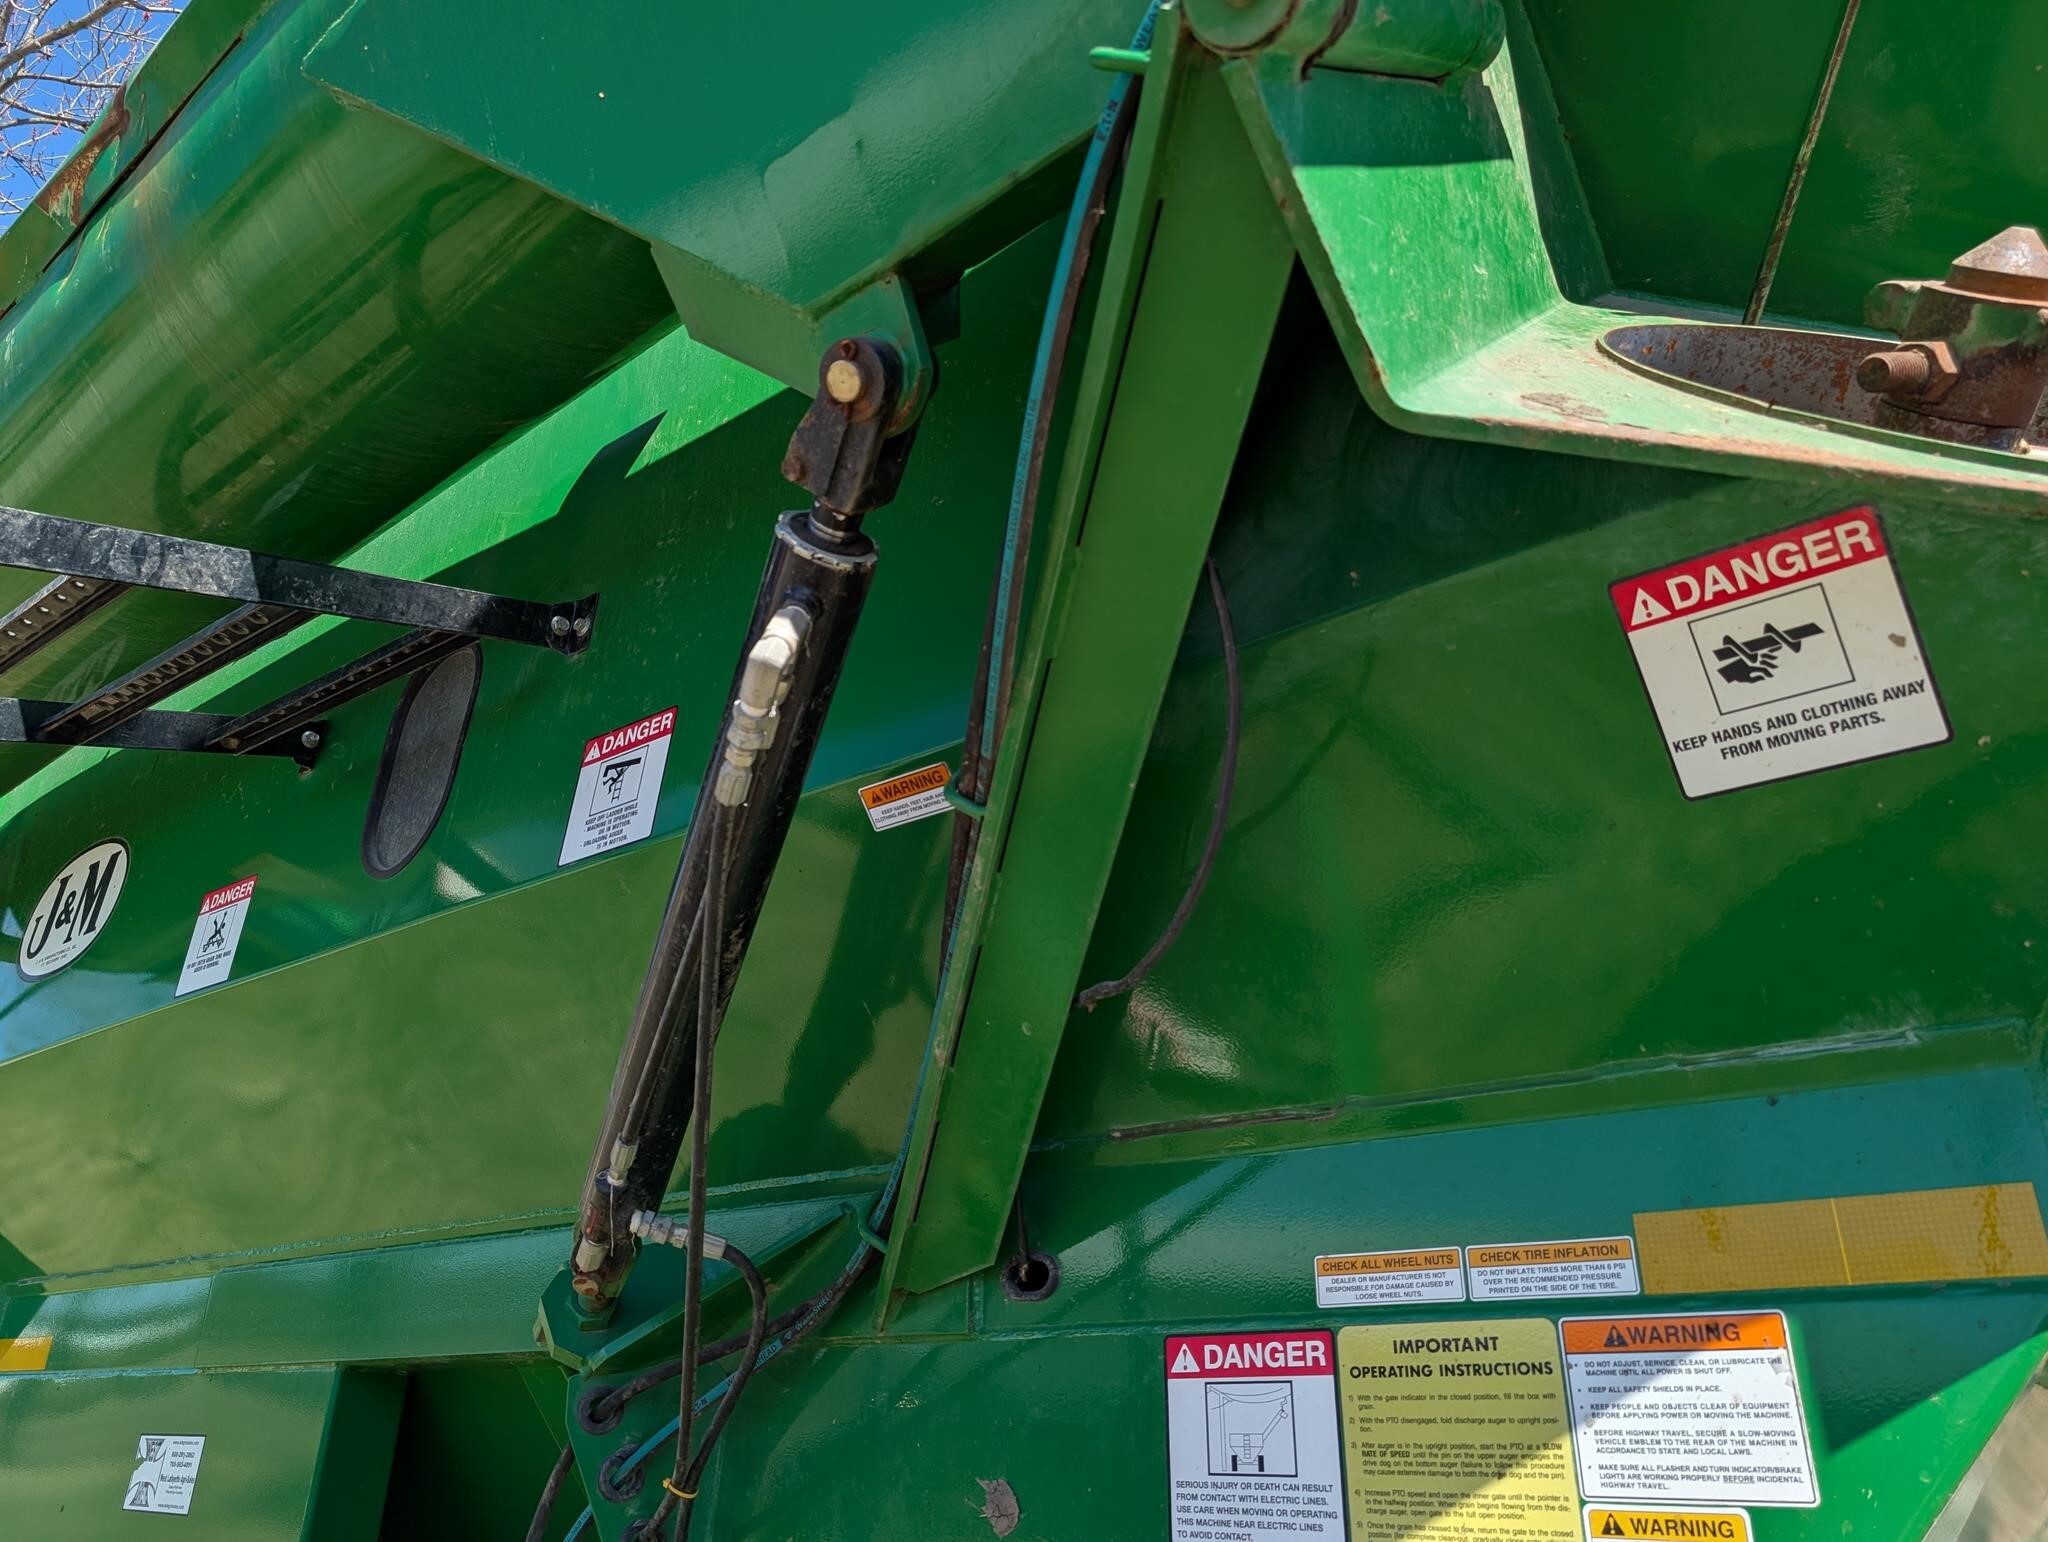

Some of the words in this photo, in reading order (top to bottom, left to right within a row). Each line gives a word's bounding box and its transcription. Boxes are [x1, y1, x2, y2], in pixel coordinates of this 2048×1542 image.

[1665, 520, 1876, 610] DANGER
[1673, 735, 1708, 753] KEEP
[1712, 722, 1762, 744] HANDS
[1766, 714, 1797, 730] AND
[1802, 693, 1878, 722] CLOTHING
[1882, 679, 1926, 703] AWAY
[602, 712, 673, 754] DANGER
[1720, 742, 1763, 760] FROM
[1766, 726, 1827, 750] MOVING
[1831, 711, 1885, 735] PARTS.
[880, 770, 943, 800] WARNING
[209, 881, 254, 909] DANGER
[27, 850, 122, 959] J&M
[1480, 1251, 1520, 1262] CHECK
[1523, 1249, 1551, 1260] TIRE
[1554, 1245, 1618, 1258] INFLATION
[1322, 1261, 1358, 1272] CHECK
[1361, 1259, 1380, 1269] ALL
[1383, 1257, 1421, 1268] WHEEL
[1424, 1254, 1454, 1265] NUTS
[1506, 1267, 1535, 1275] INFLATE
[1369, 1273, 1422, 1282] MANUFACTURER
[1520, 1274, 1578, 1284] RECOMMENDED
[1326, 1284, 1369, 1293] RESPONSIBLE
[1371, 1282, 1384, 1290] FOR
[1356, 1292, 1377, 1300] LOOSE
[1489, 1286, 1519, 1294] PRINTED
[1627, 1323, 1740, 1344] WARNING
[1393, 1337, 1498, 1354] IMPORTANT
[1203, 1340, 1327, 1369] DANGER
[1350, 1365, 1432, 1378] OPERATING
[1439, 1362, 1553, 1377] INSTRUCTIONS
[1176, 1481, 1209, 1489] SERIOUS
[1211, 1482, 1238, 1490] INJURY
[1241, 1482, 1252, 1490] OR
[1254, 1483, 1280, 1491] DEATH
[1302, 1484, 1333, 1492] RESULT
[1177, 1493, 1198, 1501] FROM
[1200, 1494, 1236, 1502] CONTACT
[1238, 1495, 1258, 1503] WITH
[1261, 1496, 1300, 1504] ELECTRIC
[1302, 1497, 1328, 1505] LINES.
[1193, 1506, 1214, 1514] CARE
[1242, 1508, 1273, 1516] MOVING
[1276, 1509, 1288, 1517] OR
[1290, 1510, 1337, 1519] OPERATING
[1196, 1519, 1231, 1527] MACHINE
[1234, 1520, 1255, 1528] NEAR
[1257, 1521, 1297, 1530] ELECTRIC
[1299, 1523, 1323, 1532] LINES
[1629, 1517, 1734, 1538] WARNING
[1177, 1530, 1188, 1538] TO
[1189, 1531, 1212, 1539] AVOID
[1214, 1532, 1253, 1541] CONTACT.
